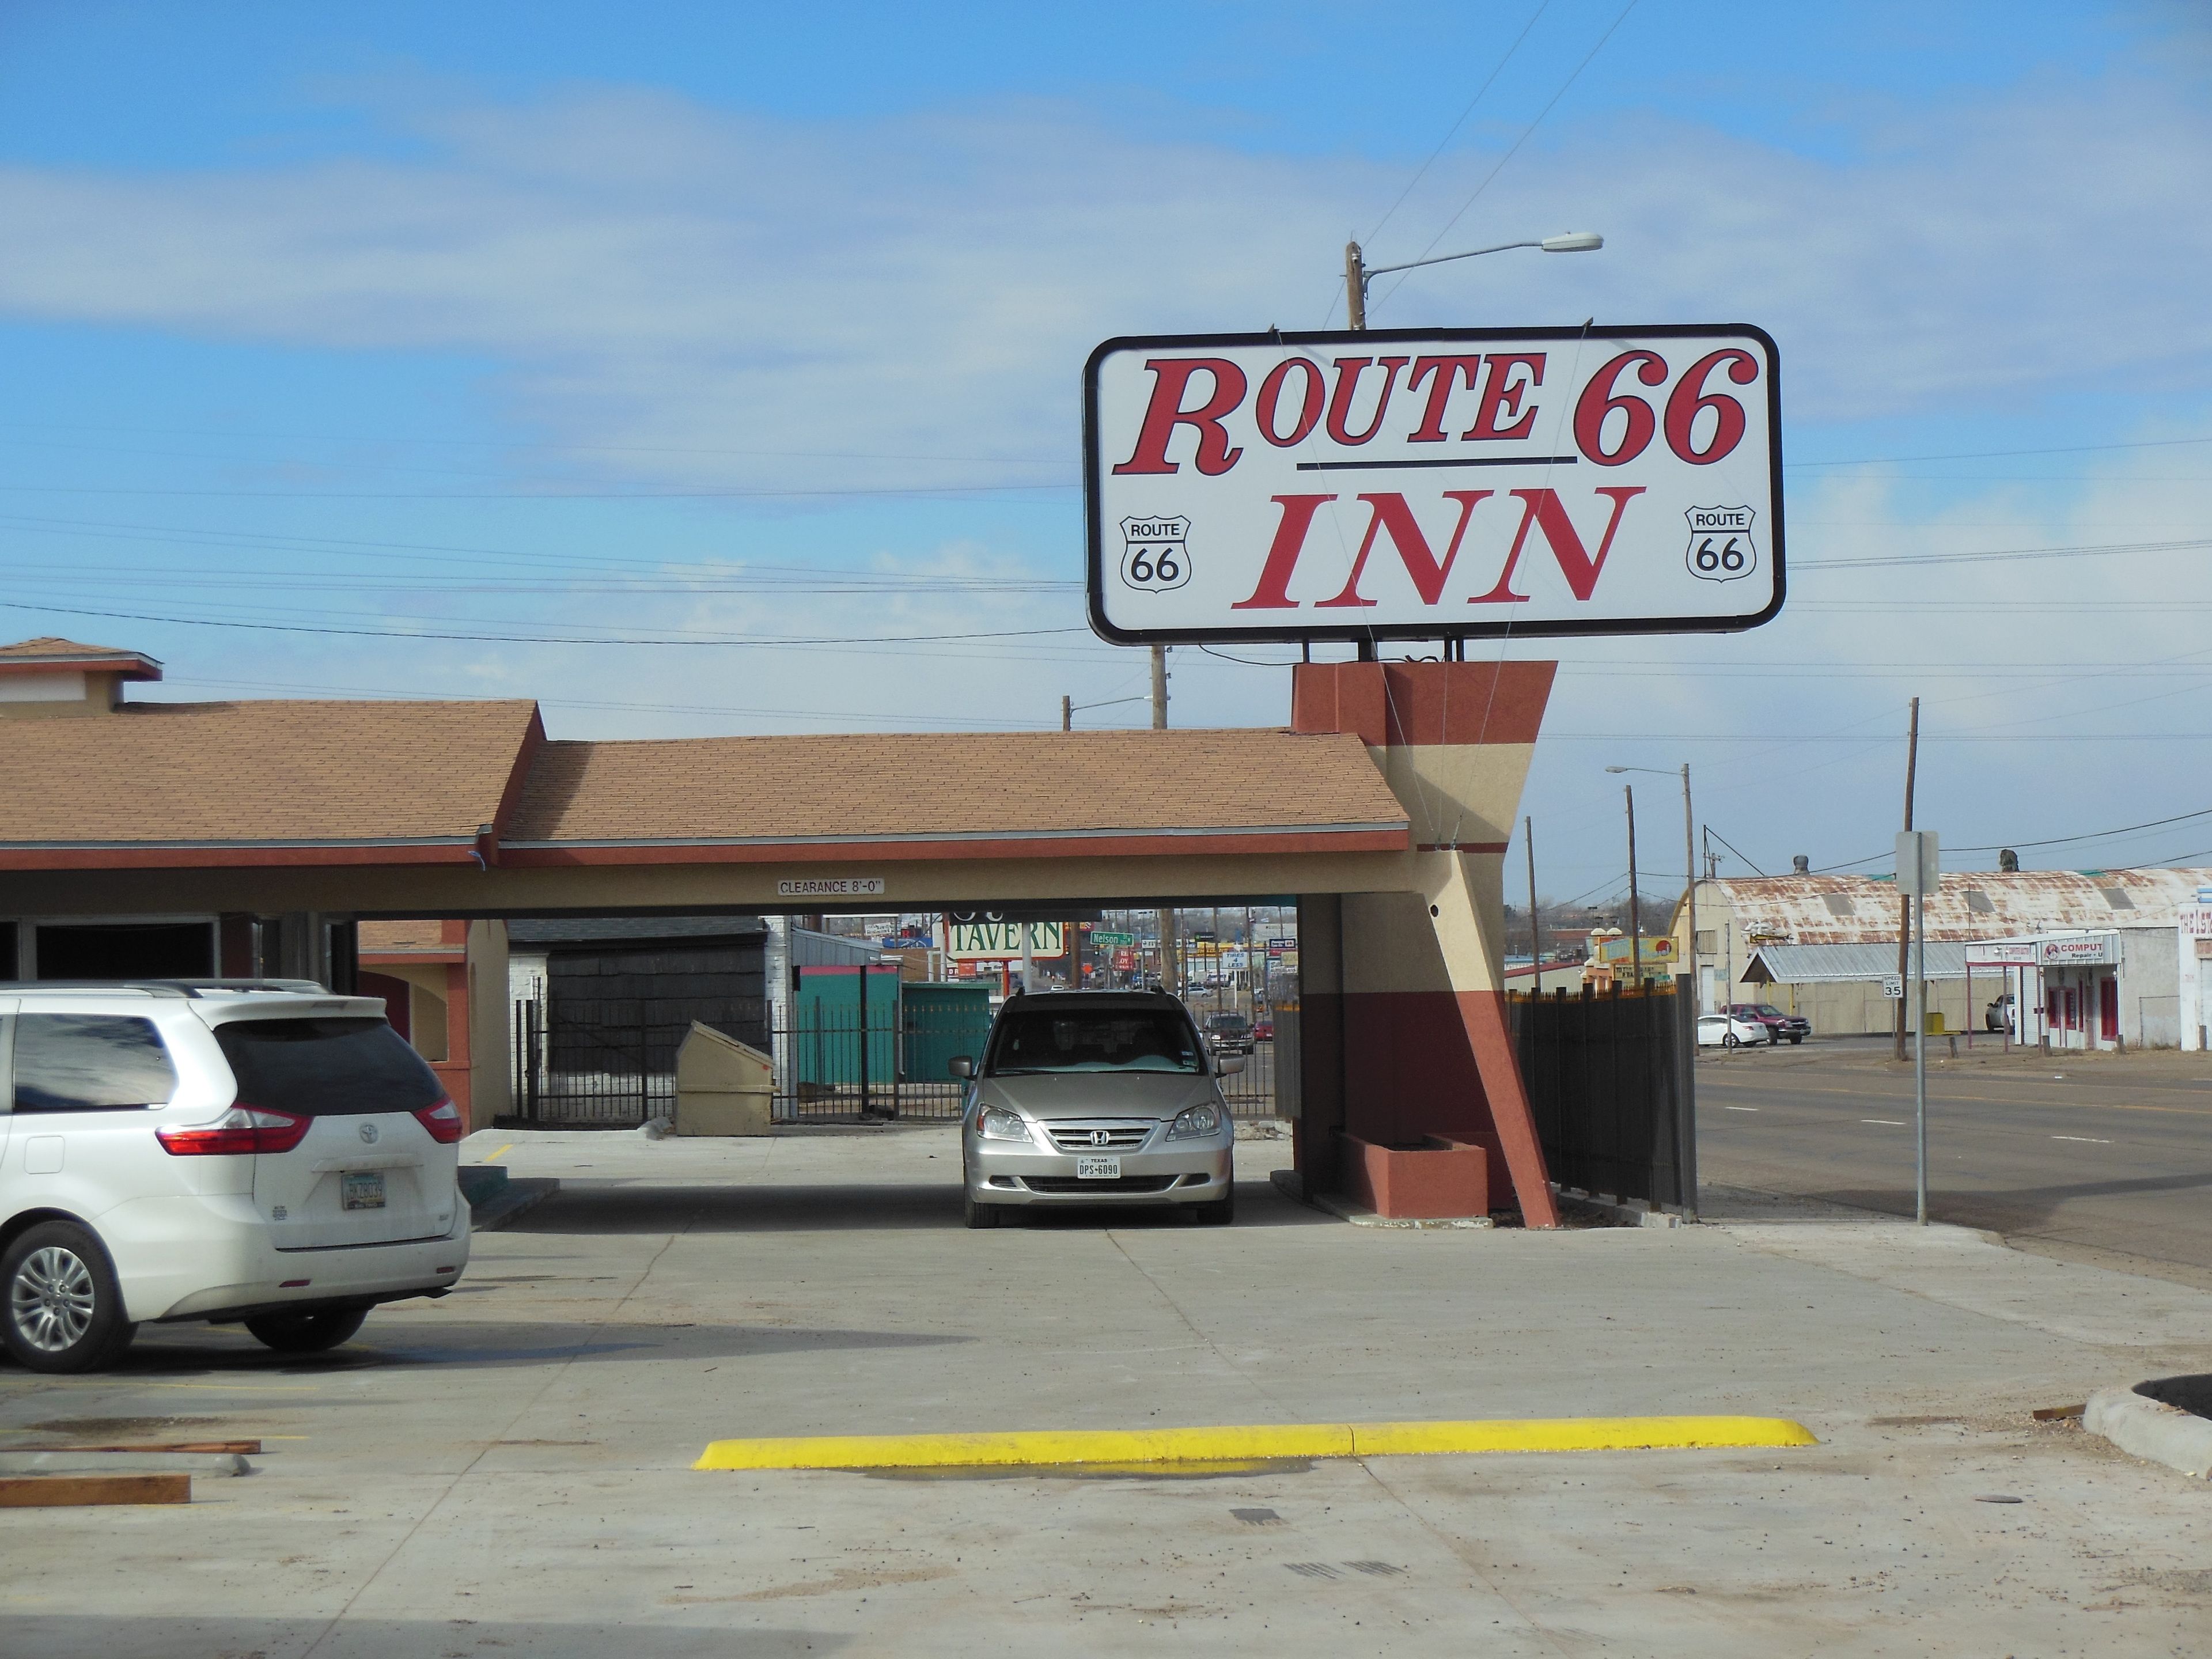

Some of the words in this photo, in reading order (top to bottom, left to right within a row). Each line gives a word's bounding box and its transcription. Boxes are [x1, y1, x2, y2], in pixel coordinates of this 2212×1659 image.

[1111, 352, 1547, 476] ROUTE
[1573, 349, 1759, 466] 66
[1696, 513, 1745, 526] ROUTE
[1131, 524, 1180, 536] ROUTE
[1231, 485, 1647, 609] INN
[1696, 537, 1744, 571] 66
[1131, 547, 1179, 582] 66
[780, 881, 847, 893] CLEARANCE
[950, 922, 1061, 951] TAVERN
[1094, 933, 1118, 944] Nelson
[2061, 944, 2103, 952] COMPUT
[1885, 986, 1900, 995] 35
